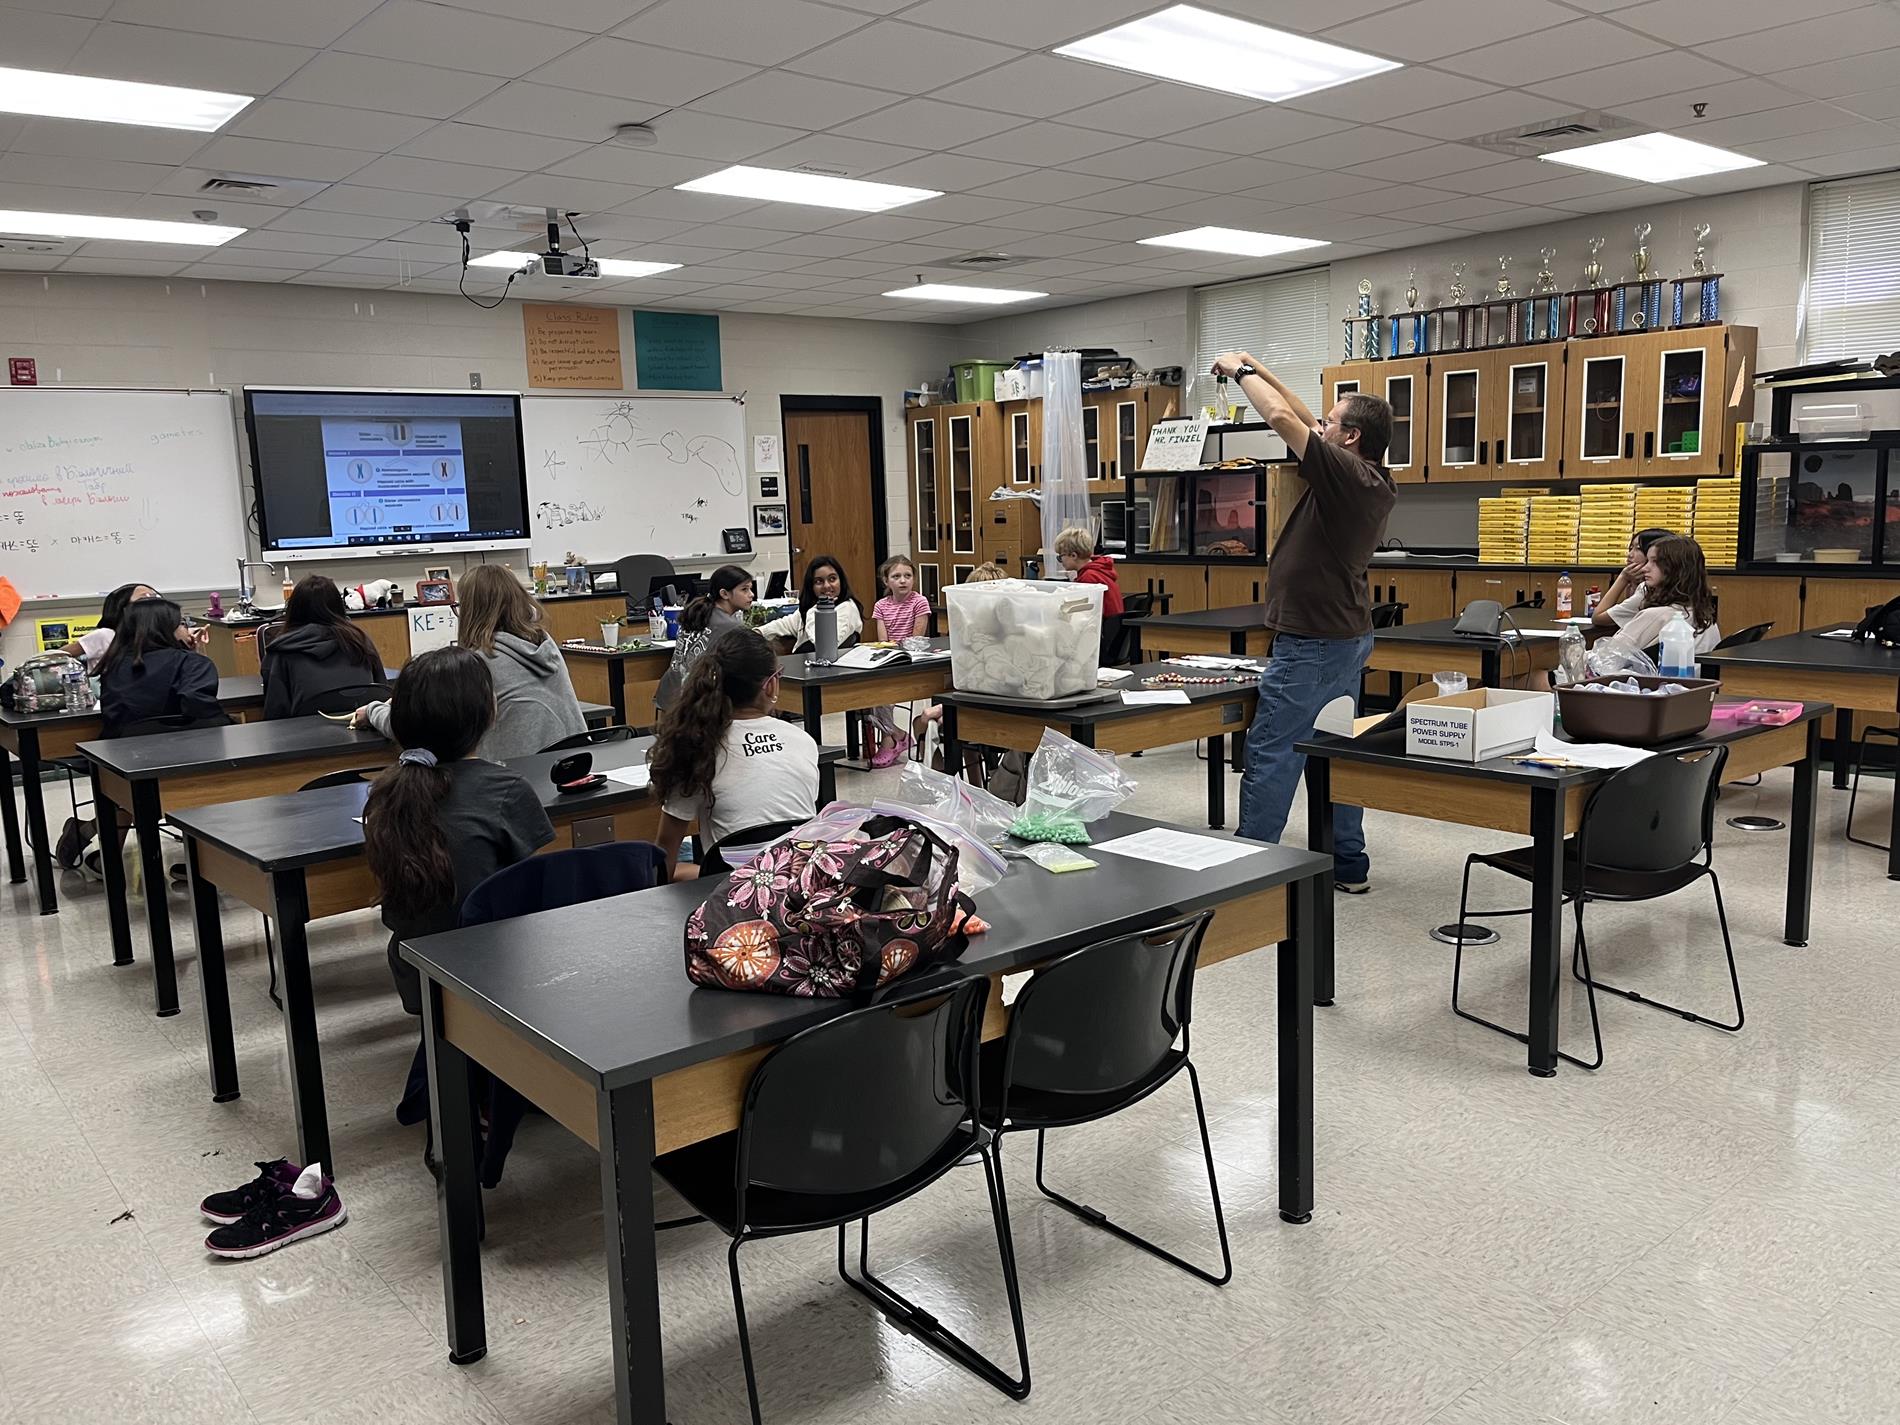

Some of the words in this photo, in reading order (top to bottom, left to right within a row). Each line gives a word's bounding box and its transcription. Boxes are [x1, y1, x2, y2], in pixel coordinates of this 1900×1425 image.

[1152, 426, 1177, 436] THANK
[1184, 424, 1200, 433] YOU
[1168, 434, 1202, 444] FINZEL
[413, 612, 436, 632] KE
[1410, 718, 1448, 727] SPECTRUM
[1450, 722, 1468, 730] TUBE
[744, 732, 777, 745] Care
[1412, 728, 1438, 737] POWER
[1439, 730, 1466, 740] SUPPLY
[1418, 738, 1438, 746] MODEL
[742, 743, 783, 757] Bears
